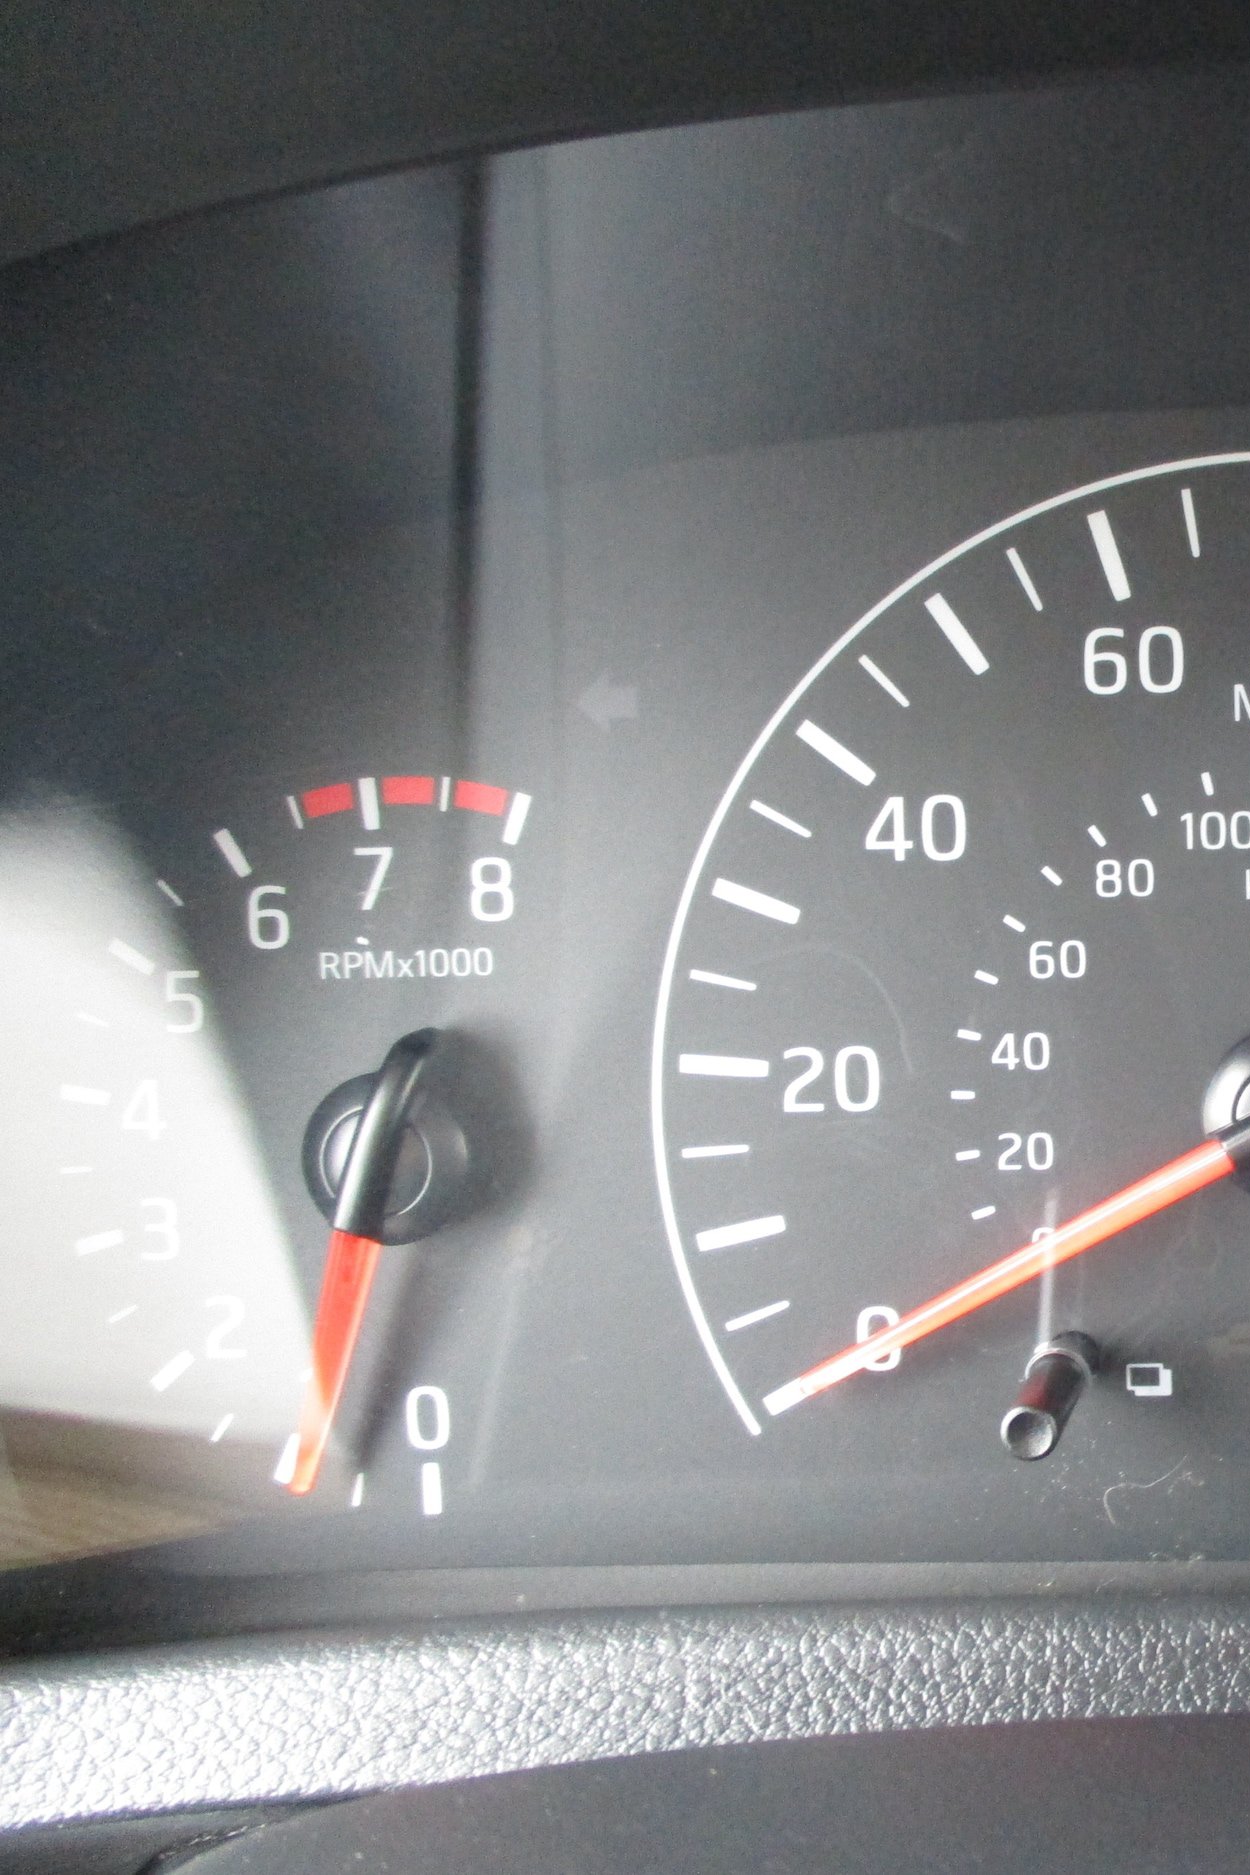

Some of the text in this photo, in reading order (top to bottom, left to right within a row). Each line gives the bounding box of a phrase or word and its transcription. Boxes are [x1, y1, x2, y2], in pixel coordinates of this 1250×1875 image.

[1083, 625, 1184, 695] 60
[864, 794, 967, 862] 40
[354, 846, 393, 911] 7
[470, 856, 515, 923] 8
[1095, 858, 1155, 898] 80
[248, 884, 290, 950] 6
[1029, 939, 1087, 980] 60
[165, 971, 203, 1033] 5
[782, 1045, 881, 1113] 20
[991, 1031, 1050, 1071] 40
[121, 1078, 168, 1141] 4
[997, 1131, 1054, 1171] 20
[140, 1196, 181, 1262] 3
[204, 1293, 248, 1360] 2
[857, 1305, 901, 1372] 0
[405, 1385, 451, 1451] 0
